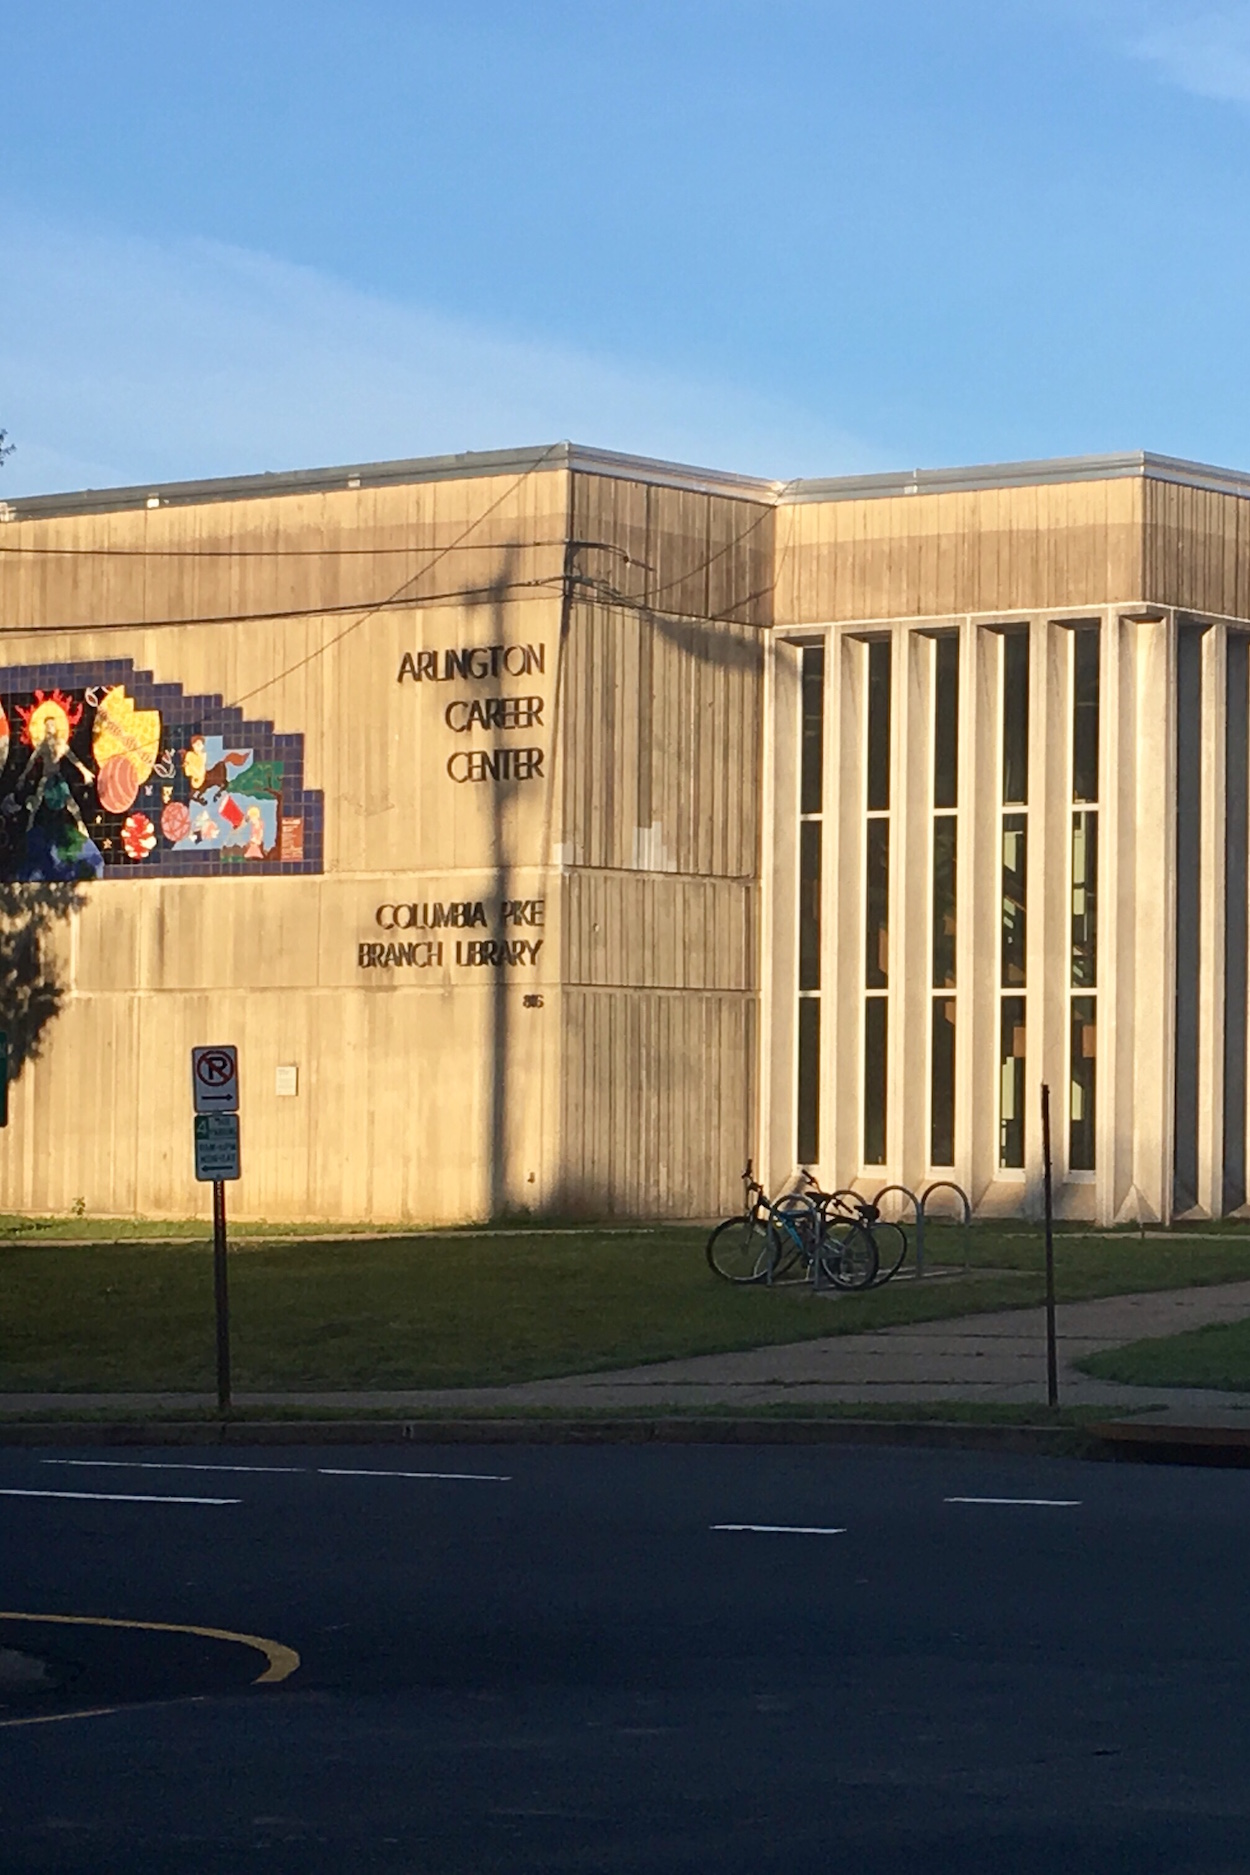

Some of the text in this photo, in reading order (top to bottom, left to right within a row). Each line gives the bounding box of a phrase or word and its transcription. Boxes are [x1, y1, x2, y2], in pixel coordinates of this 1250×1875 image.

[397, 643, 545, 683] ARLINGTON
[445, 696, 545, 732] CAREER
[447, 747, 545, 783] CENTER
[376, 899, 545, 929] COLUMBIA PIKE
[358, 939, 543, 969] BRANCH LIBRARY
